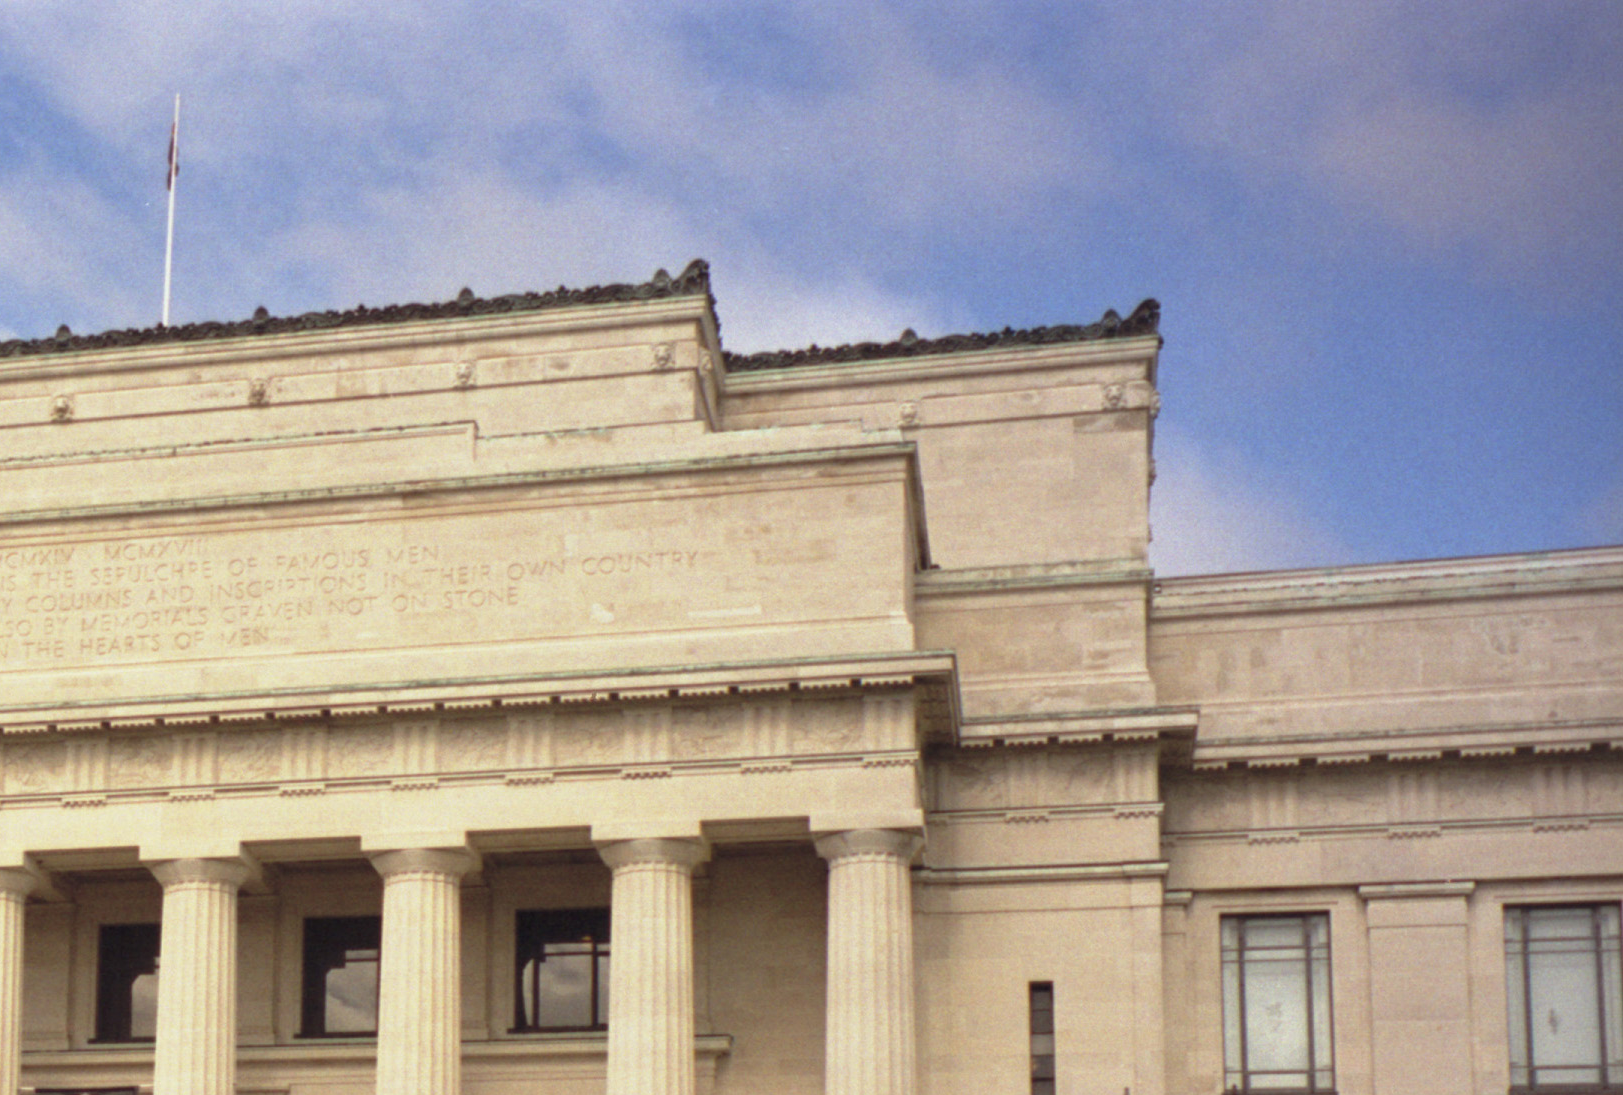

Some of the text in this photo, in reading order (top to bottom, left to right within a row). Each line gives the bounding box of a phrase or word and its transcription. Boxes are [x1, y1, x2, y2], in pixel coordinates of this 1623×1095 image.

[0, 575, 17, 592] IS
[31, 569, 74, 588] THE
[90, 560, 213, 585] SEPULCHRE
[228, 557, 257, 577] OF
[277, 549, 369, 571] FAMOUS
[387, 545, 439, 564] MEN
[27, 589, 132, 613] COLUMNS
[146, 585, 195, 603] AND
[209, 573, 367, 600] INSCRIPTIONS
[383, 572, 408, 589] IN
[422, 564, 491, 585] THEIR
[506, 559, 566, 580] OWN
[581, 551, 698, 576] COUNTRY
[44, 616, 68, 635] BY
[81, 607, 208, 632] MEMORIALS
[222, 601, 313, 623] GRAVEN
[329, 596, 377, 616] NOT
[392, 593, 426, 612] ON
[443, 586, 518, 609] STONE
[22, 640, 65, 659] THE
[79, 634, 160, 656] HEARTS
[175, 630, 205, 650] OF
[221, 626, 269, 646] MEN
